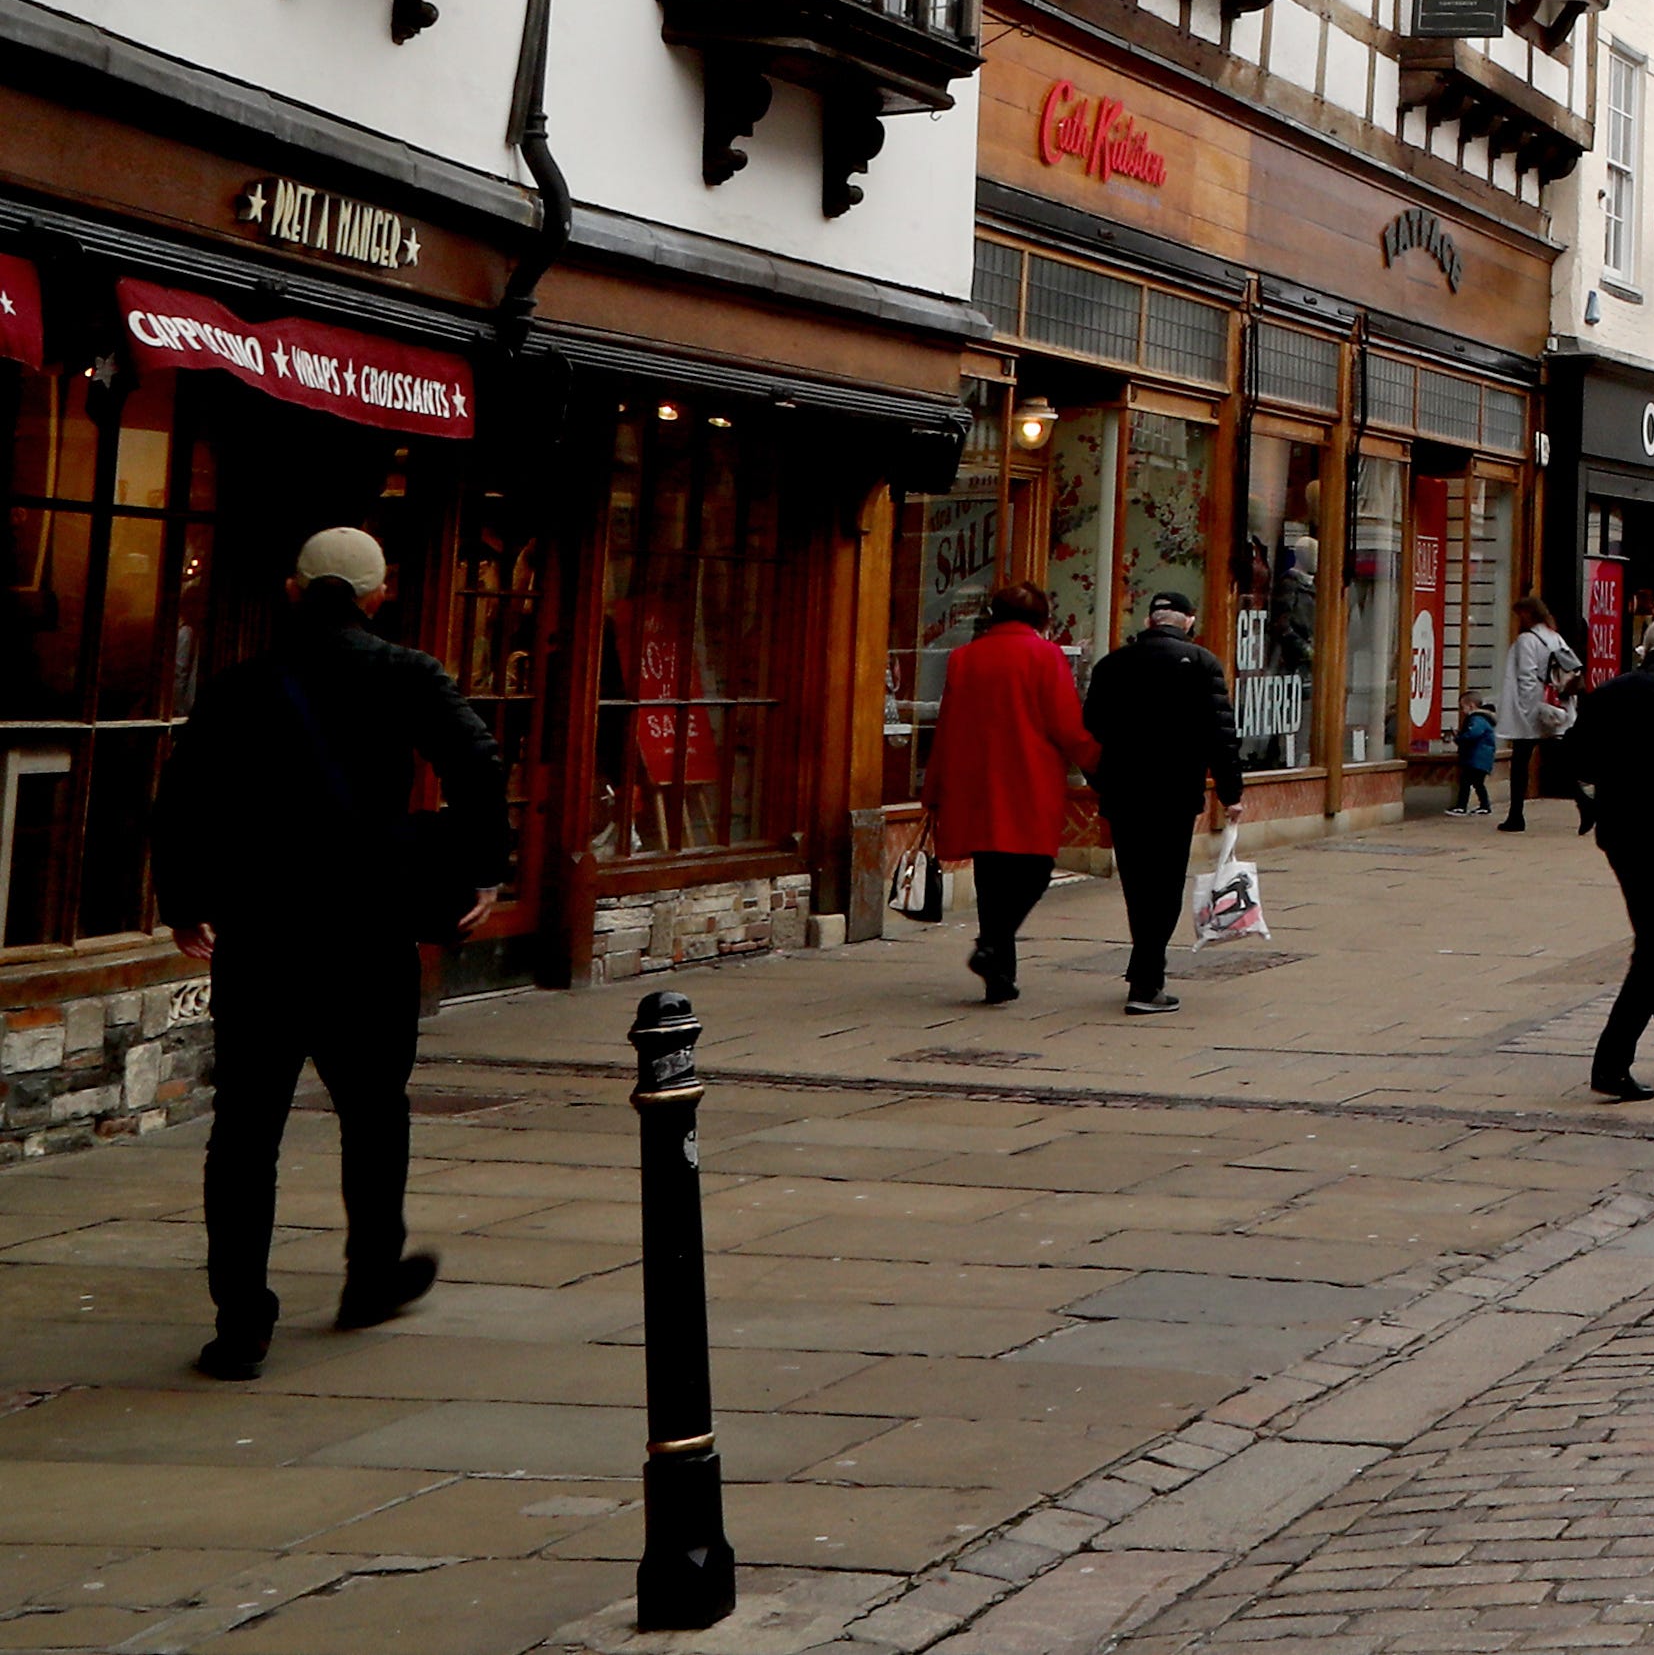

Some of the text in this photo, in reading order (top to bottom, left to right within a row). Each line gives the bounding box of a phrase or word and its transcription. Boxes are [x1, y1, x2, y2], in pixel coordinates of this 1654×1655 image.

[1039, 80, 1090, 165] Cath
[270, 178, 402, 269] PRET A MANGER
[1382, 207, 1463, 295] FATFACE
[127, 306, 451, 419] CAPPUCCINO WRAPS CROISSANTS
[935, 508, 997, 596] SALE
[1236, 609, 1268, 672] GET
[645, 713, 700, 739] SAE
[1234, 673, 1303, 739] LAYERED
